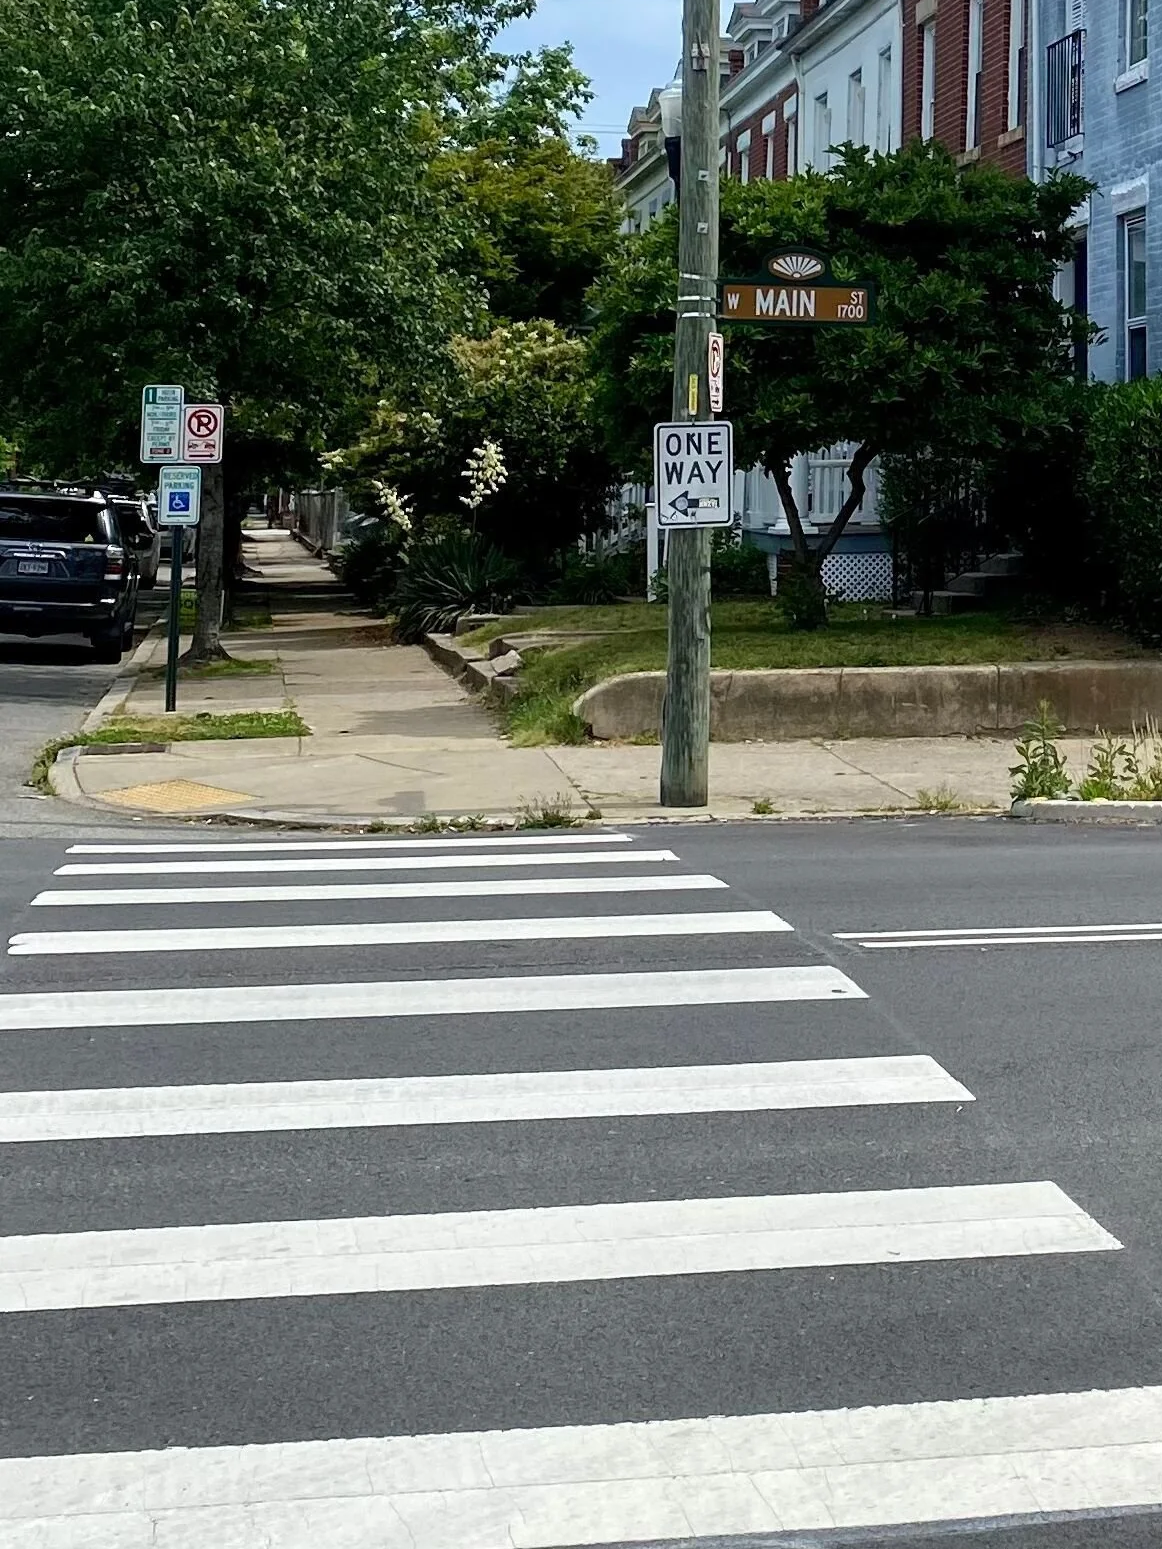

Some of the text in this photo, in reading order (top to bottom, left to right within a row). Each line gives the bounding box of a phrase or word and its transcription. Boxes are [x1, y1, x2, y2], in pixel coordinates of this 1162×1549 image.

[727, 288, 865, 318] W MAIN ST
[837, 304, 864, 319] 1700
[665, 431, 723, 457] ONE
[664, 459, 724, 485] WAY
